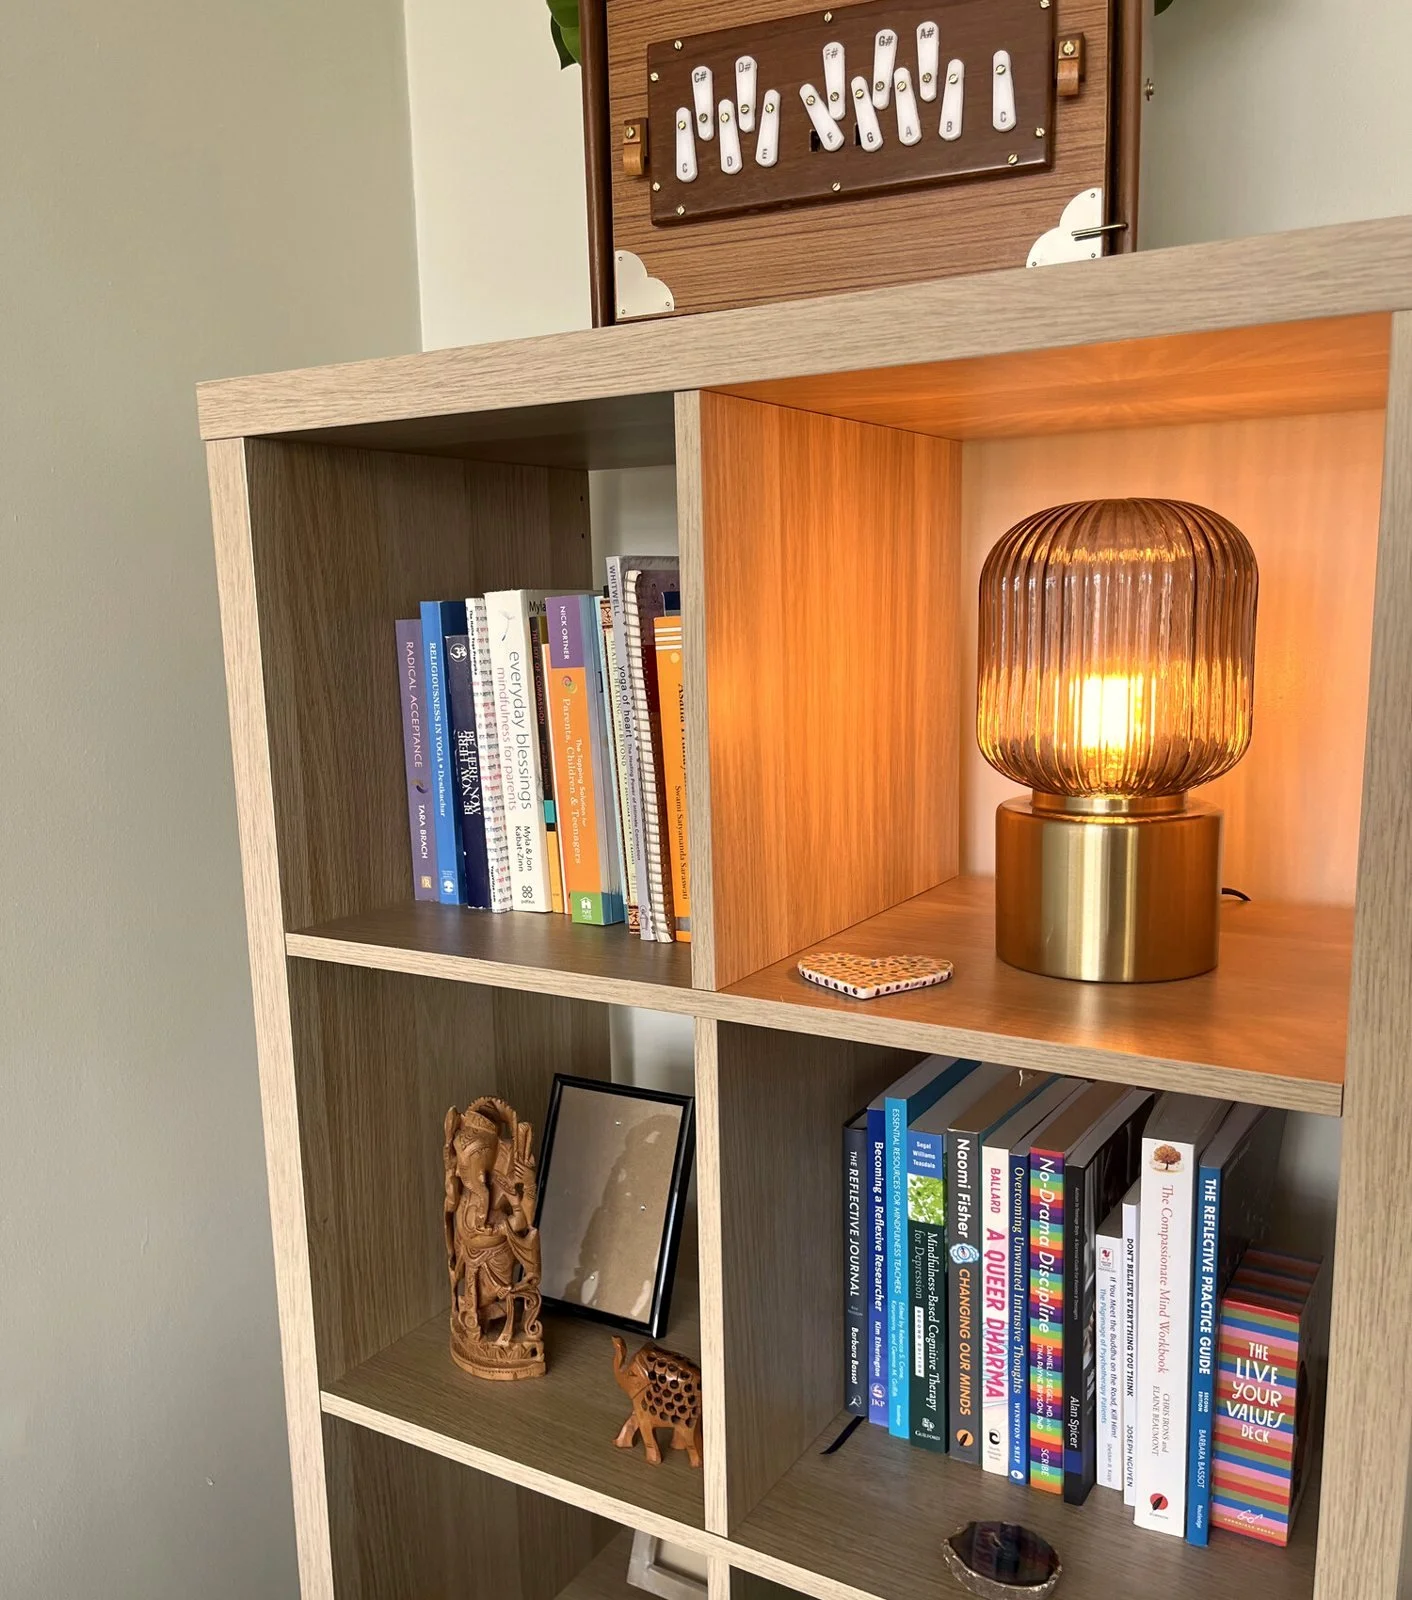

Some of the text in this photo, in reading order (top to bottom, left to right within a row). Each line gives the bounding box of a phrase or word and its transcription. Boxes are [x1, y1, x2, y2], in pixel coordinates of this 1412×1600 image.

[879, 36, 894, 46] G#
[920, 27, 934, 40] A#
[738, 62, 751, 72] D#
[825, 48, 838, 60] F#
[694, 71, 706, 83] C#
[905, 126, 912, 137] A
[946, 121, 952, 132] B
[1000, 111, 1007, 122] C
[827, 132, 833, 143] F
[867, 132, 873, 142] G
[682, 163, 688, 173] C
[727, 156, 732, 166] D
[762, 148, 768, 159] E
[609, 565, 620, 616] WHITWELL
[529, 601, 546, 615] Myla
[562, 628, 570, 659] ORTNER
[429, 643, 441, 721] RELIGIOUSNESS
[406, 642, 423, 768] RADICAL ACCEPTANCE
[535, 675, 545, 724] COMPASSION
[618, 665, 633, 737] yoga of heart
[435, 723, 442, 734] IN
[497, 667, 516, 811] mindfulness for parents
[509, 651, 532, 809] everyday blessings
[436, 736, 444, 762] YOGA
[458, 730, 473, 815] BE NOW HERE
[466, 731, 481, 815] BE HERE NOW
[562, 699, 580, 864] Parents, Children & Teenagers
[579, 787, 587, 815] Solution
[420, 829, 428, 859] BRACH
[515, 826, 524, 872] Kabat-Zinn
[523, 825, 531, 845] Myla
[675, 785, 689, 900] Swami Satyananda Saraswati
[892, 1109, 900, 1145] ESSENTIAL
[913, 1150, 936, 1160] Williams
[917, 1141, 931, 1150] Segal
[913, 1159, 936, 1169] Teasdale
[850, 1168, 859, 1237] REFLECTIVE
[957, 1139, 971, 1238] Naomi Fisher
[991, 1168, 1001, 1213] BALLARD
[873, 1142, 884, 1312] Becoming a Reflexive Researcher
[1036, 1157, 1055, 1333] No-Drama Discipline
[850, 1238, 860, 1296] JOURNAL
[913, 1230, 925, 1299] for Depression
[1158, 1184, 1174, 1374] The Compassionate Mind Workbook
[1199, 1179, 1216, 1375] THE REFLECTIVE PRACTICE GUIDE
[1012, 1167, 1025, 1394] Overcoming Unwanted Intrusive Thoughts
[926, 1232, 940, 1411] Mindfulness-Based Cognitive Therapy
[984, 1228, 1005, 1397] A QUEER DHARMA
[1099, 1302, 1107, 1338] Pilgrimage
[851, 1327, 859, 1384] Barbara Bassot
[873, 1336, 882, 1377] Etherington
[959, 1268, 971, 1415] CHANGING OUR MINDS
[1100, 1339, 1107, 1347] of
[1249, 1342, 1268, 1361] THE
[1099, 1348, 1108, 1396] Psychotherapy
[1110, 1362, 1116, 1371] on
[1236, 1357, 1278, 1386] LIVE
[1109, 1387, 1117, 1406] Road,
[1152, 1385, 1160, 1412] ELAINE
[1231, 1381, 1283, 1408] YOUR
[1068, 1396, 1080, 1448] Alan Spicer
[1162, 1417, 1170, 1440] IRONS
[1226, 1400, 1286, 1429] VALUES
[1241, 1424, 1270, 1443] DECK
[1041, 1448, 1049, 1477] SCRIBE
[1197, 1429, 1206, 1488] BARBARA BASSOT
